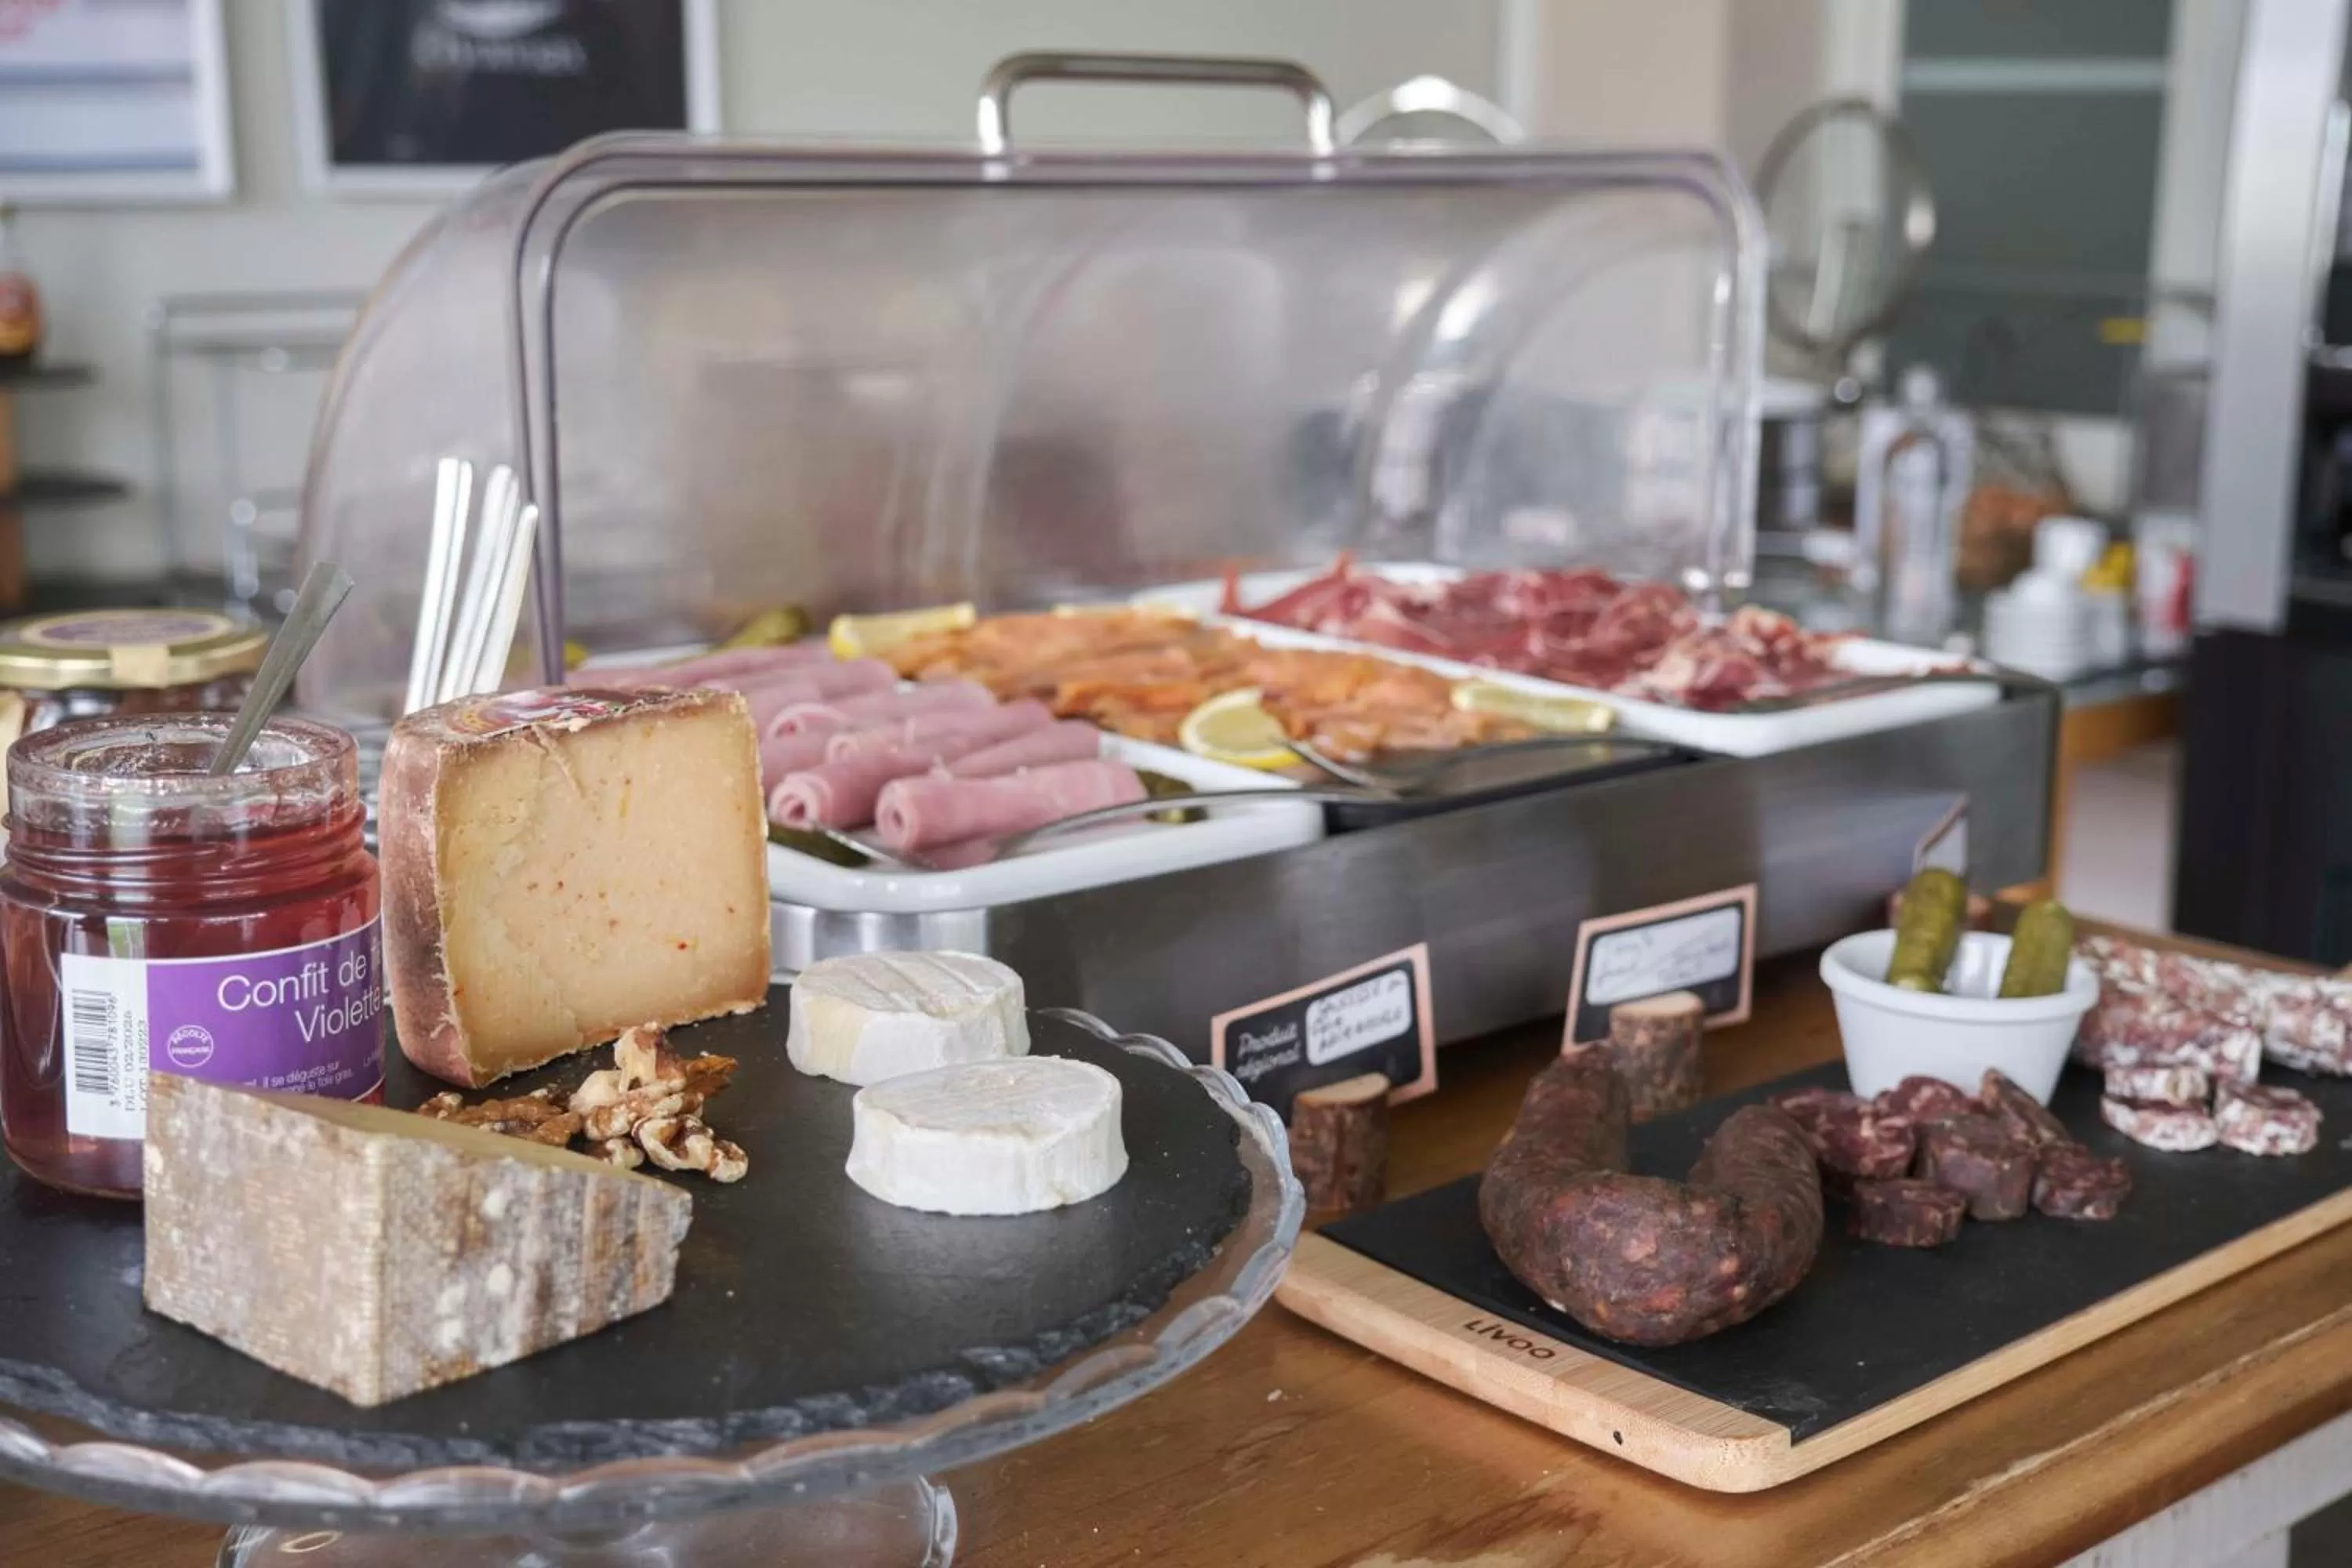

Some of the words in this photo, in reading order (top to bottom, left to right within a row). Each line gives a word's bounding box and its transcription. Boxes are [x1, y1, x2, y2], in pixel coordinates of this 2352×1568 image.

[217, 961, 330, 1011] Confit
[338, 950, 366, 987] de
[295, 985, 381, 1043] Violette
